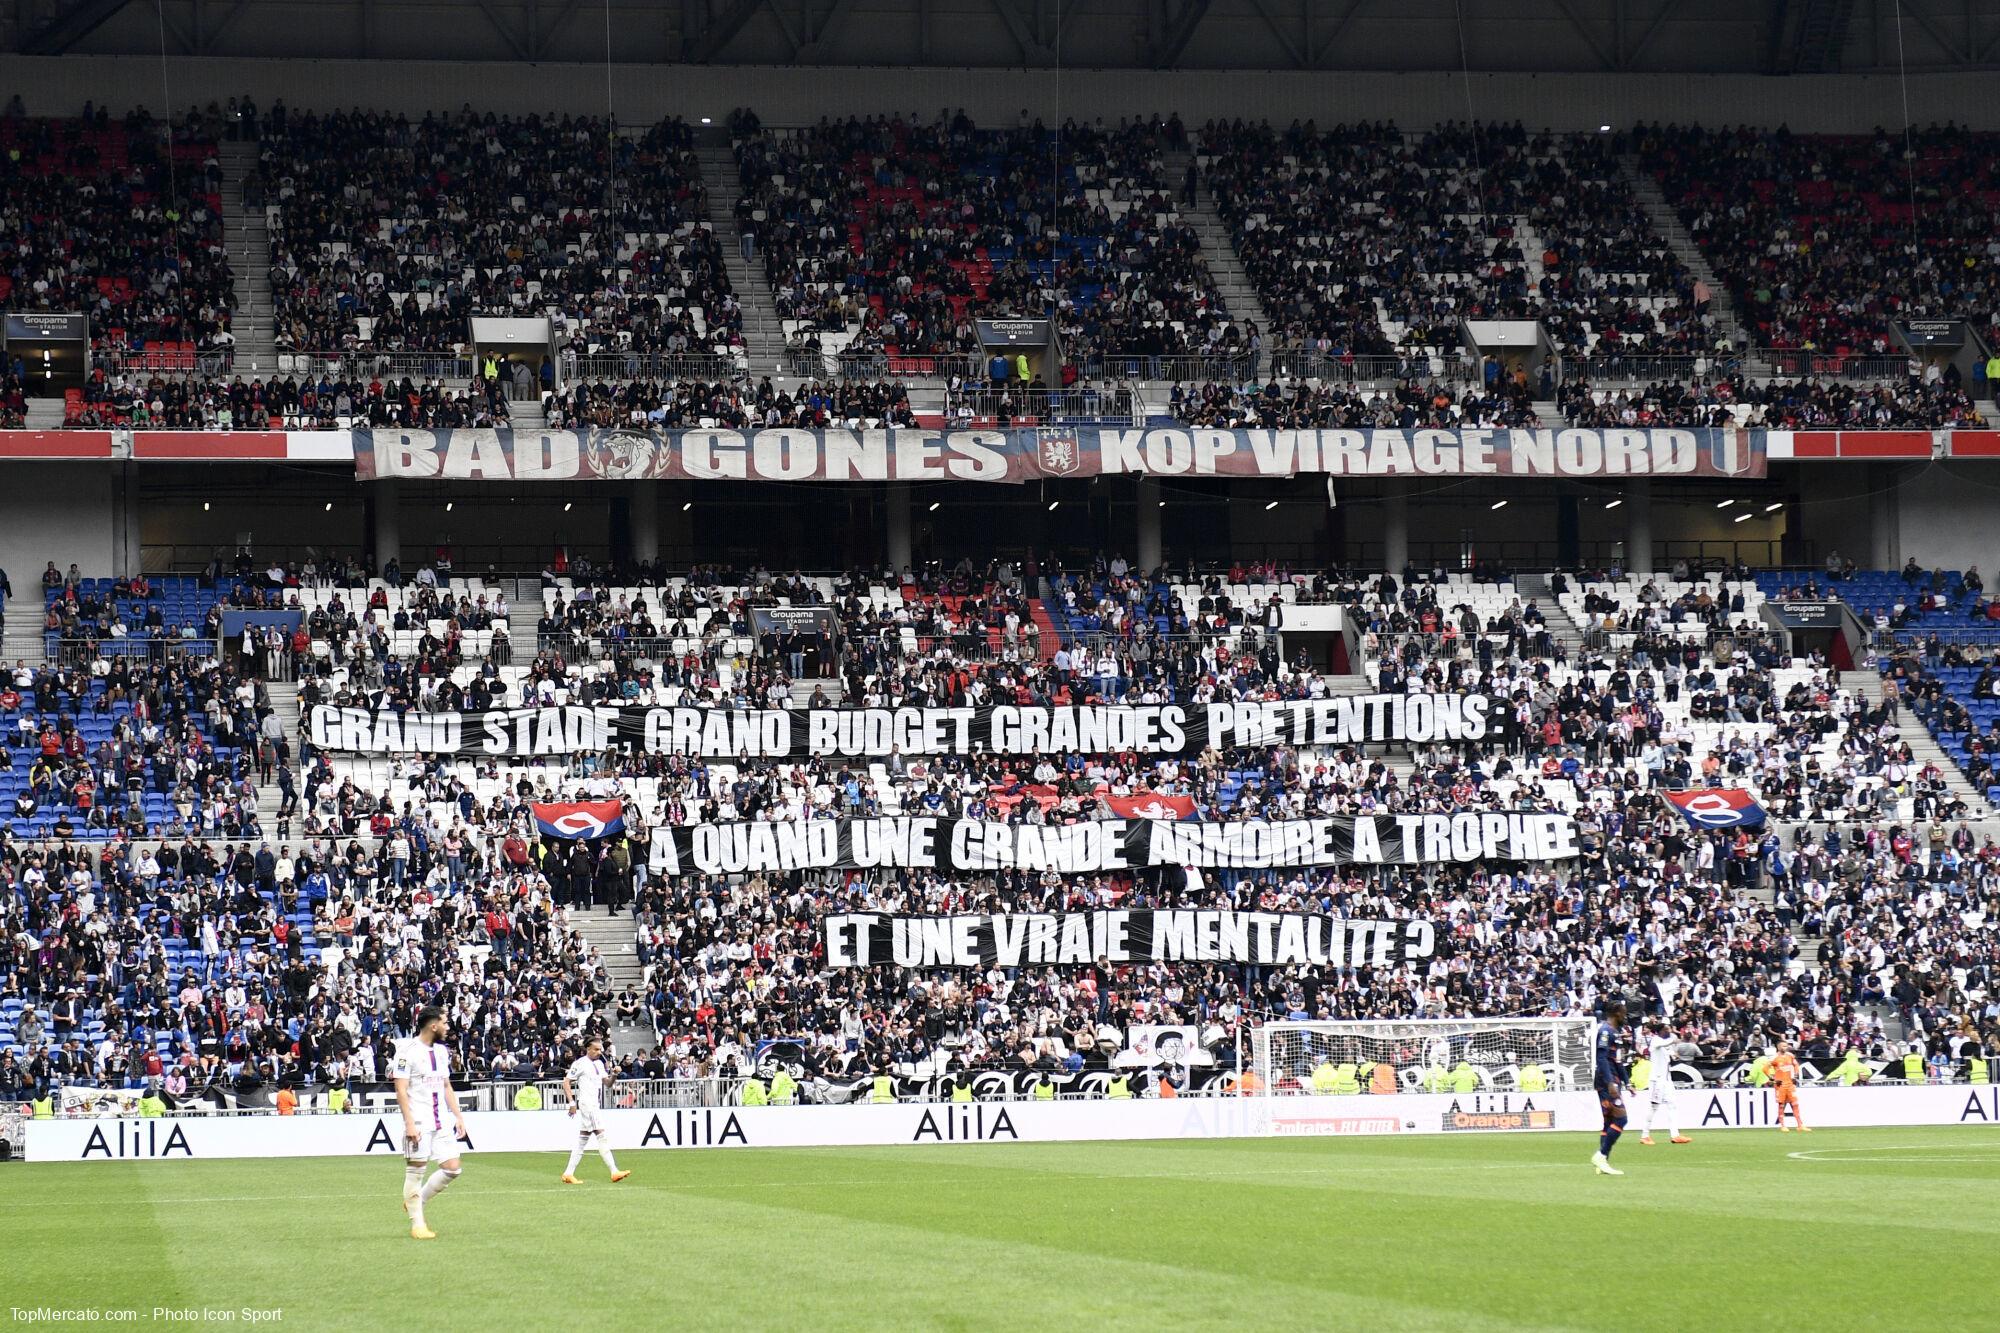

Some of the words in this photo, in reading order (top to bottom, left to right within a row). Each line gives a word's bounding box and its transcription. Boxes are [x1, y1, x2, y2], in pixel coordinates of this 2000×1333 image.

[24, 316, 67, 324] Groupama
[992, 322, 1033, 330] Groupama
[372, 428, 579, 478] BAD
[681, 428, 1008, 481] GONES
[1099, 429, 1236, 474] KOP
[1250, 429, 1496, 474] VIRAGE
[1510, 428, 1697, 474] NORD
[770, 610, 813, 619] Groupama
[1784, 604, 1825, 613] Groupama
[311, 705, 461, 752] GRAND
[483, 706, 631, 756] STADE,
[644, 708, 790, 756] GRAND
[809, 706, 982, 755] BUDGET,
[991, 705, 1185, 753] GRANDES
[649, 826, 680, 875] A
[692, 819, 838, 873] QUAND
[851, 817, 937, 868] UNE
[951, 820, 1127, 871] GRANDE
[1148, 819, 1334, 868] ARMOIRE
[1353, 816, 1384, 863] A
[1396, 812, 1579, 863] TROPHEE
[825, 915, 878, 967] ET
[892, 916, 981, 967] UNE
[991, 911, 1129, 966] VRAIE
[82, 1120, 192, 1157] AlilA
[641, 1110, 747, 1146] AlilA
[913, 1105, 1018, 1141] AlilA
[1455, 1113, 1521, 1128] Orange
